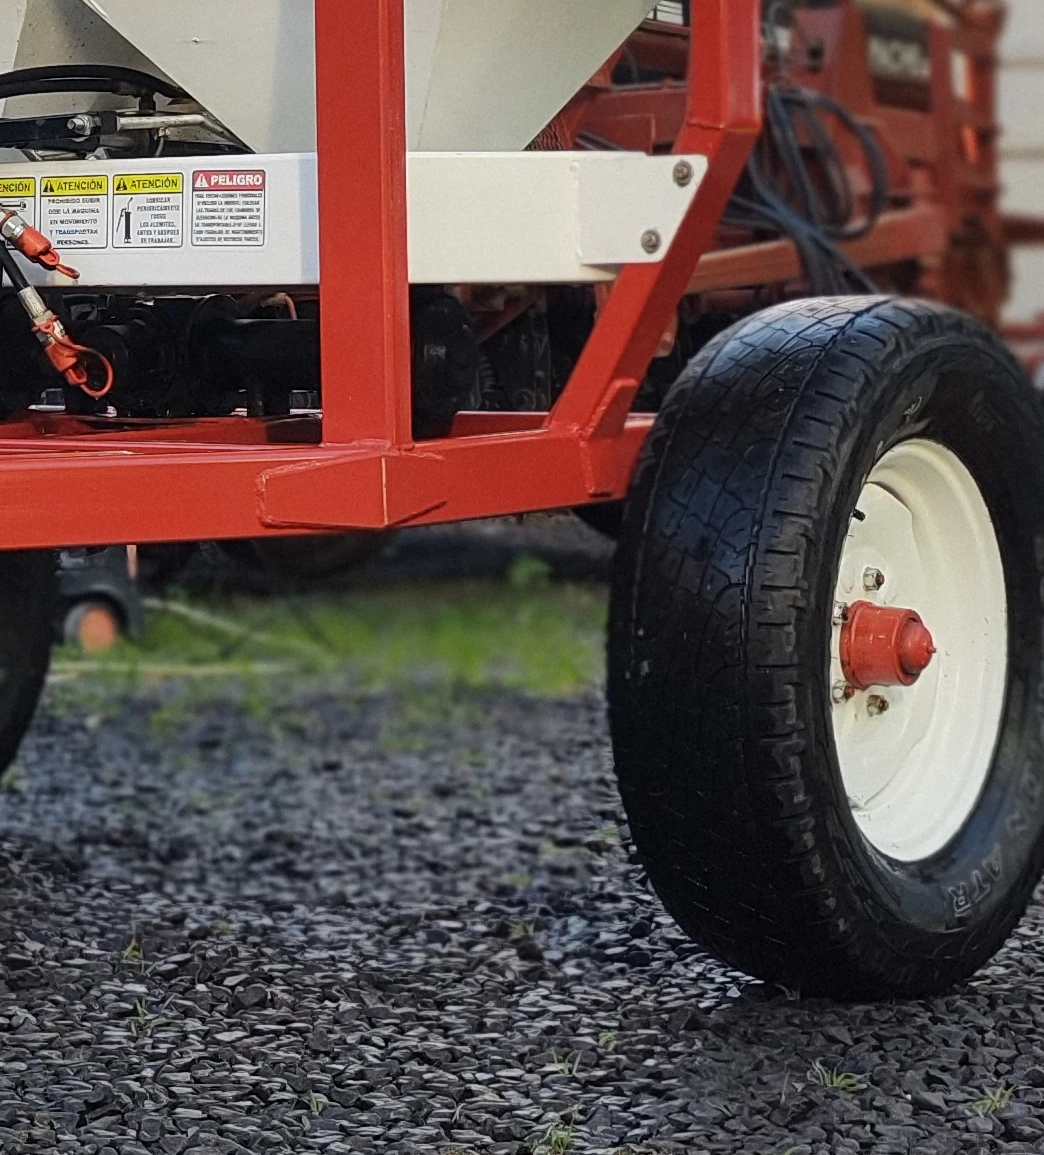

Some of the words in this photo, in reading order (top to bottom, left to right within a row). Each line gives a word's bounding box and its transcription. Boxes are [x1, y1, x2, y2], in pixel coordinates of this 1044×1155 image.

[57, 179, 103, 191] ATENCIÓN
[130, 177, 178, 189] ATENCIÓN
[210, 174, 263, 186] PELIGRO
